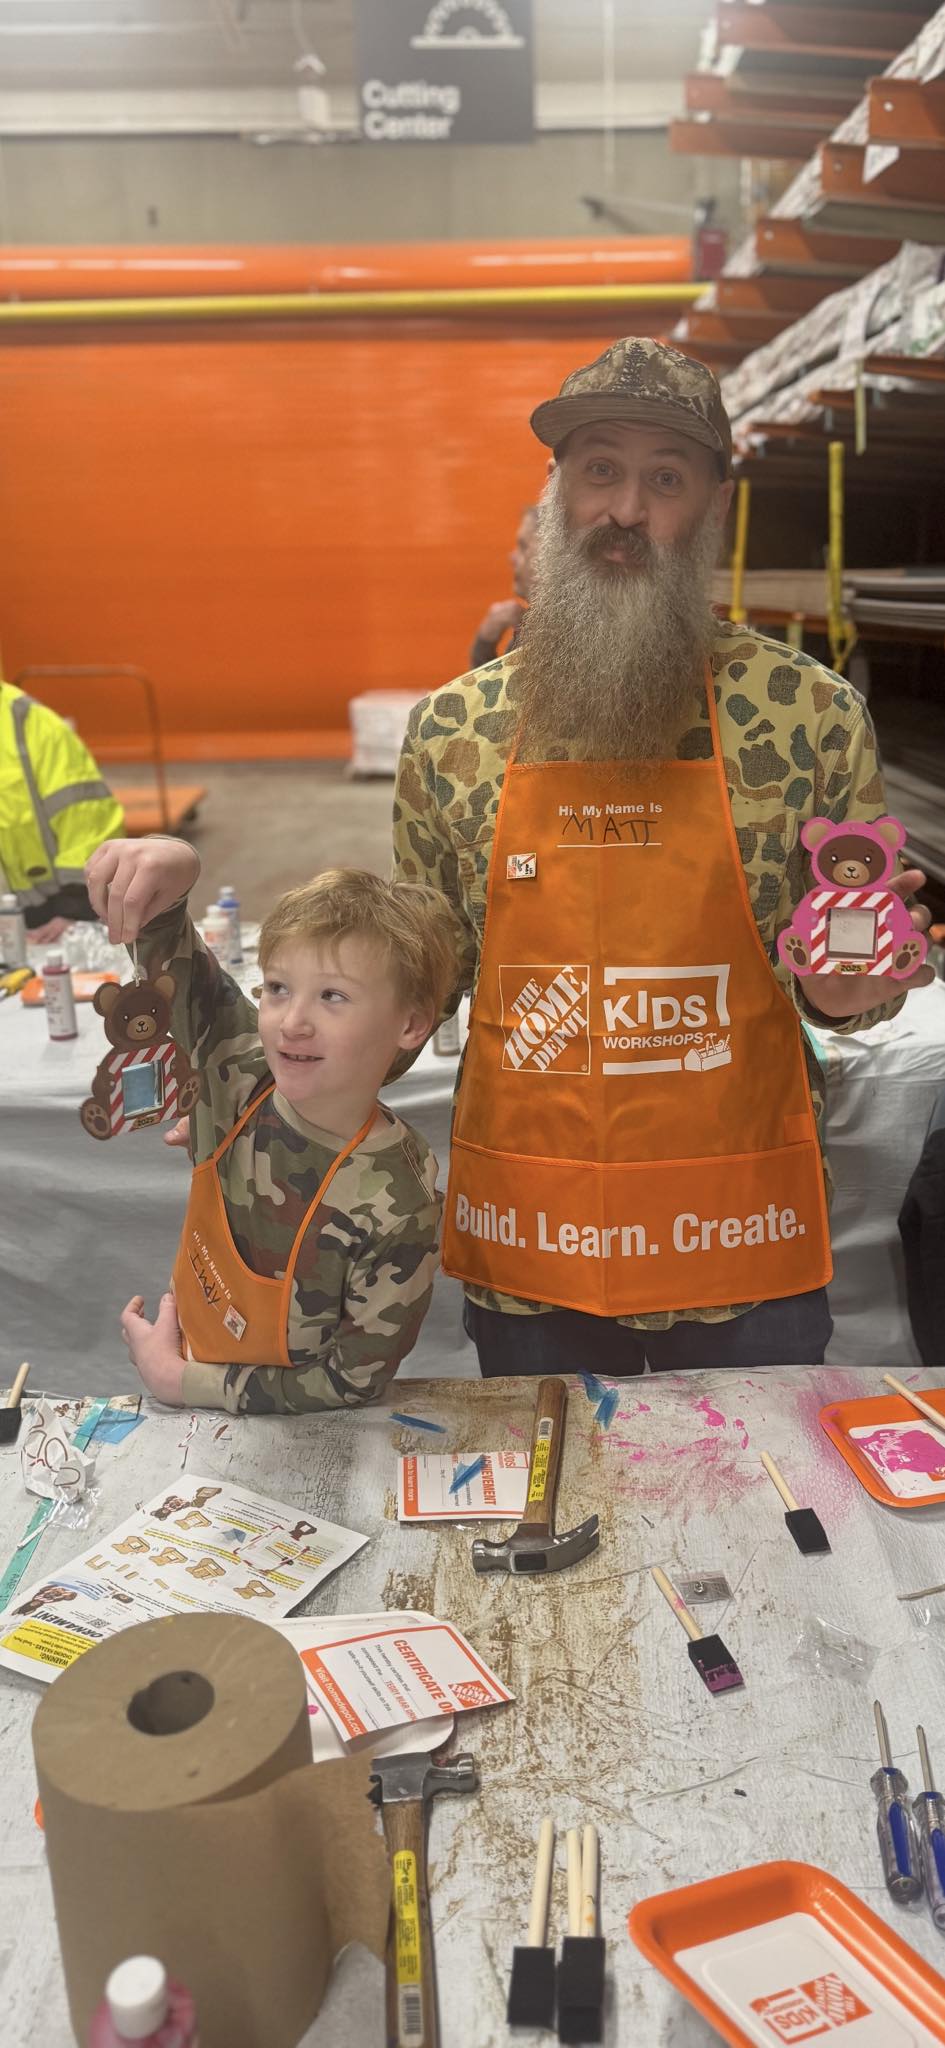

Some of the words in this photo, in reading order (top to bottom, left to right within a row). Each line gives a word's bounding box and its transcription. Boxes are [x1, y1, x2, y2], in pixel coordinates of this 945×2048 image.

[362, 79, 460, 115] Cutting
[363, 111, 452, 139] Center
[582, 805, 602, 818] My
[605, 803, 644, 814] Name
[650, 802, 663, 813] Is
[562, 814, 658, 846] MATT
[840, 964, 862, 972] 2025
[510, 978, 543, 1019] THE
[603, 990, 708, 1032] KIDS
[504, 964, 589, 1070] HOME
[532, 1006, 588, 1071] DEPOT
[603, 1032, 704, 1049] WORKSHOPS
[455, 1193, 526, 1248] Build.
[537, 1211, 659, 1259] Learn.
[673, 1203, 806, 1253] Create.
[201, 1245, 210, 1261] My
[208, 1260, 225, 1289] Name
[482, 1455, 496, 1505] ACHIEVEMENT
[31, 1610, 104, 1638] ORNAMENT
[316, 1666, 330, 1683] Visit
[393, 1639, 442, 1700] CERTIFICATE
[774, 2005, 820, 2030] KIDS
